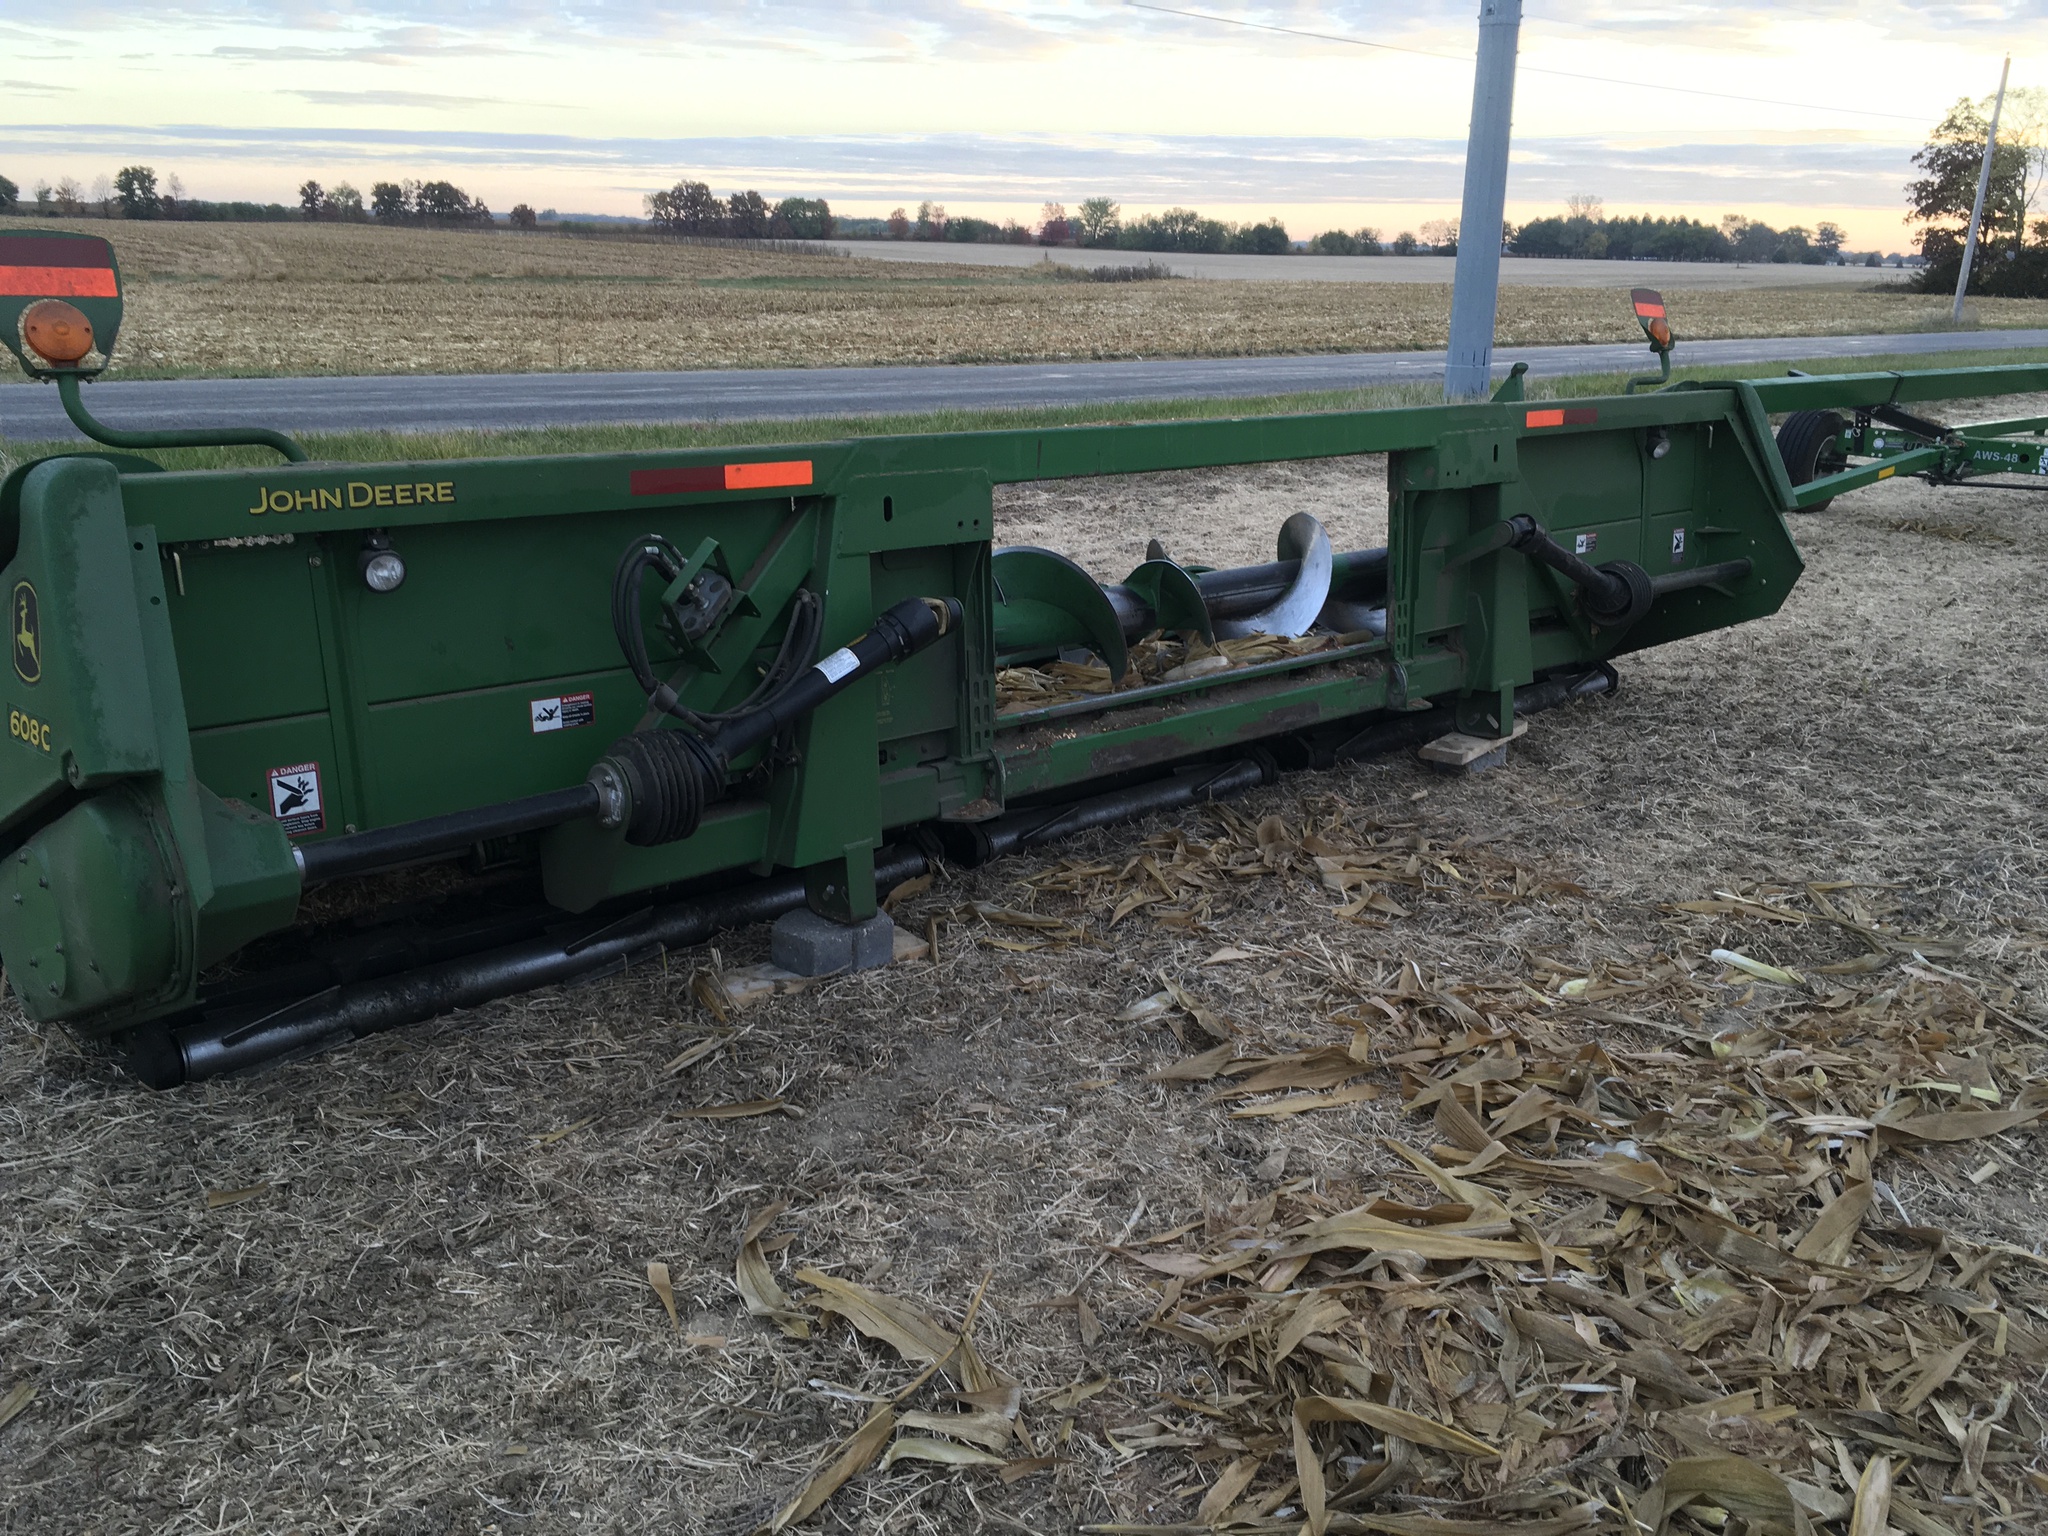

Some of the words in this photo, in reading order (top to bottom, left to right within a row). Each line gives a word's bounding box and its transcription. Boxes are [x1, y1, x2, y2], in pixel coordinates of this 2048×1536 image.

[1973, 450, 2019, 463] AWS-48
[250, 486, 343, 514] JOHN
[348, 482, 455, 508] DEERE
[568, 694, 590, 702] DANGER
[10, 710, 51, 752] 608C
[280, 763, 316, 776] DANGER
